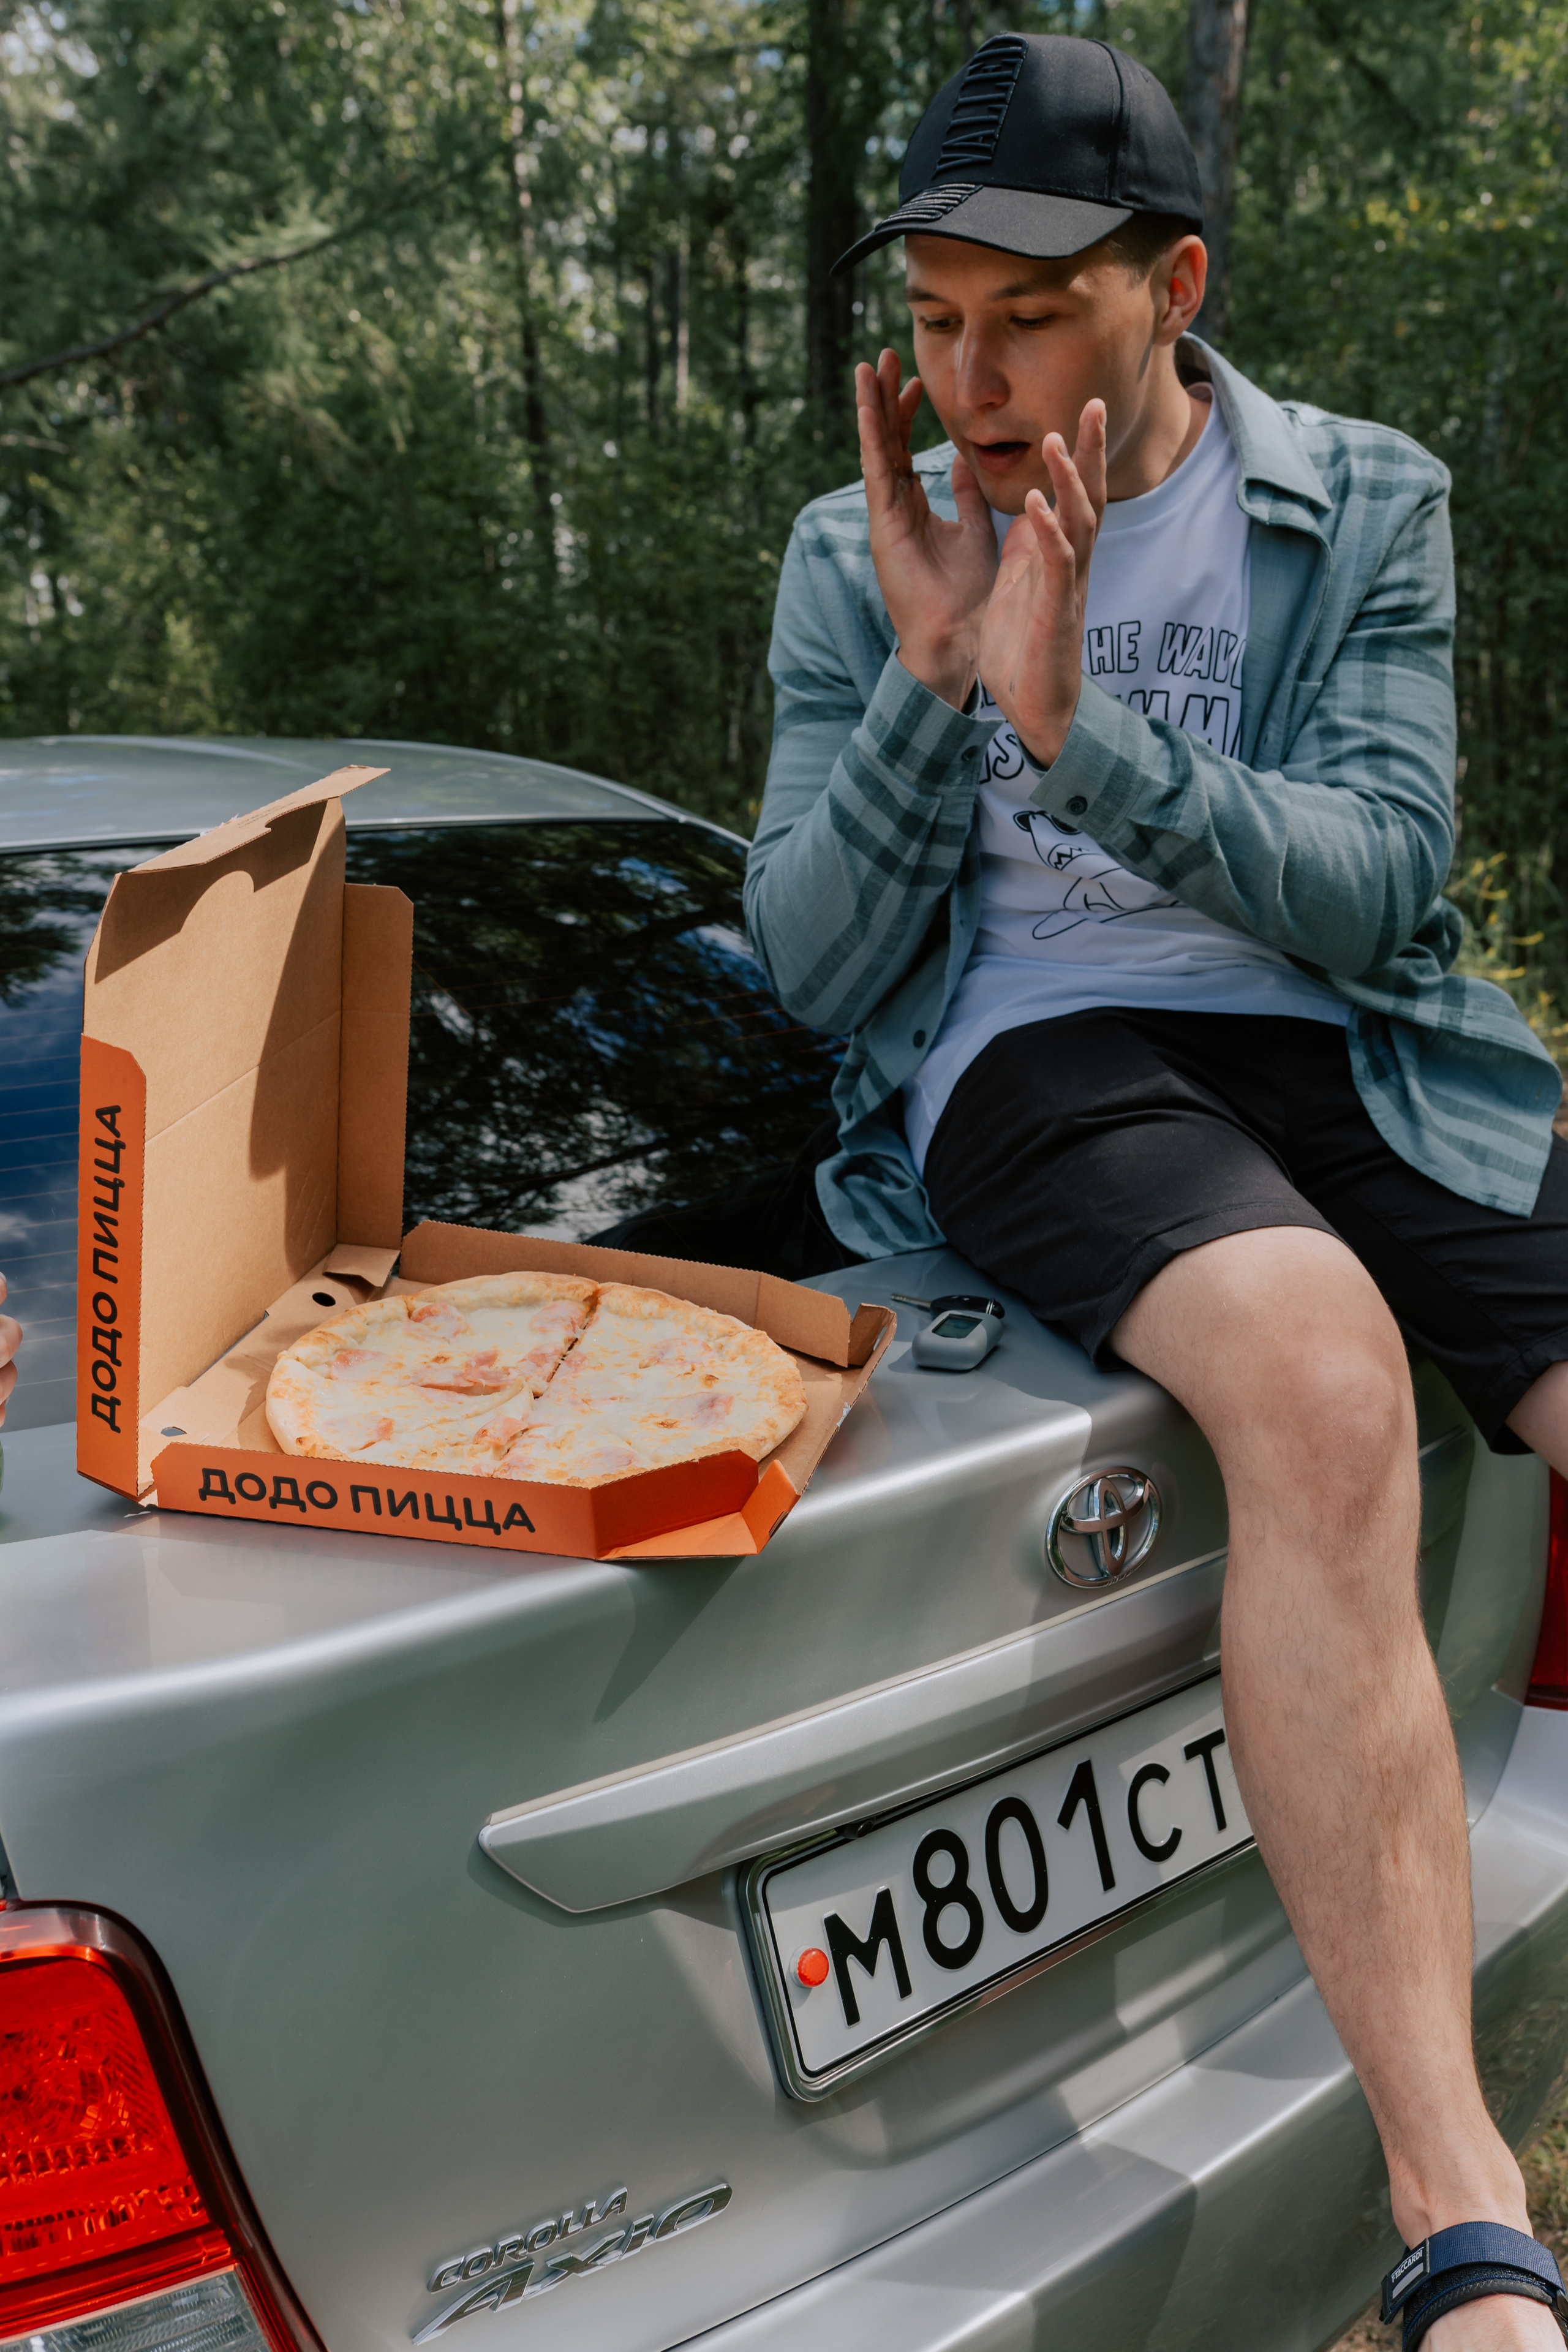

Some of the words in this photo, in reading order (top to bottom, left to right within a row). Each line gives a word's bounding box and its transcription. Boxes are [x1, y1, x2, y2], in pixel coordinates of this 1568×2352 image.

[1082, 620, 1141, 676] HE
[92, 1104, 126, 1284] ПИЦЦА
[91, 1291, 122, 1434] ДОДО
[198, 1468, 338, 1513] ДОДО
[350, 1484, 536, 1536] ПИЦЦА
[428, 2187, 628, 2294] COROLLA
